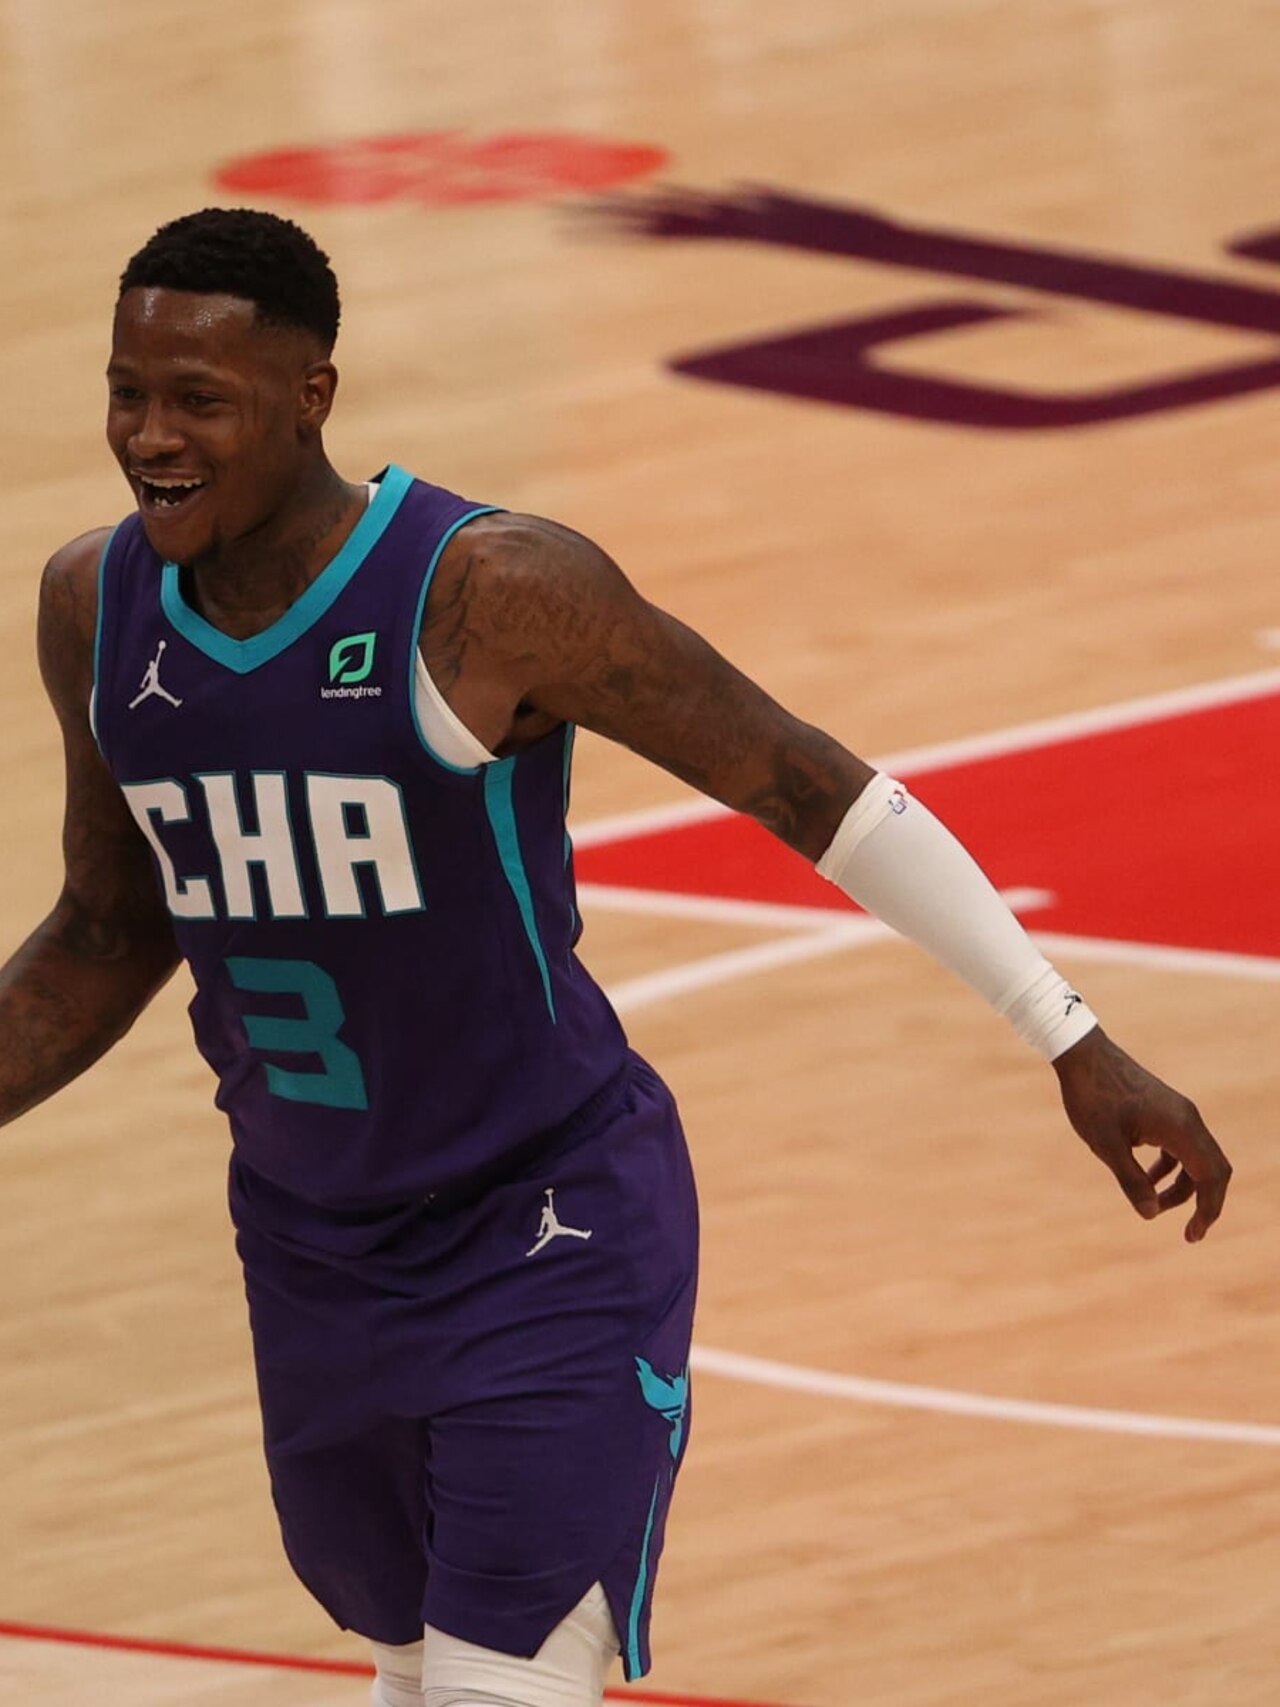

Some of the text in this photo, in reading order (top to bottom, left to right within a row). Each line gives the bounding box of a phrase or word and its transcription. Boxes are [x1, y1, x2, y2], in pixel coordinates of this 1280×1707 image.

[320, 685, 382, 699] lendingtree
[120, 770, 426, 922] CHA
[224, 956, 368, 1110] 3
